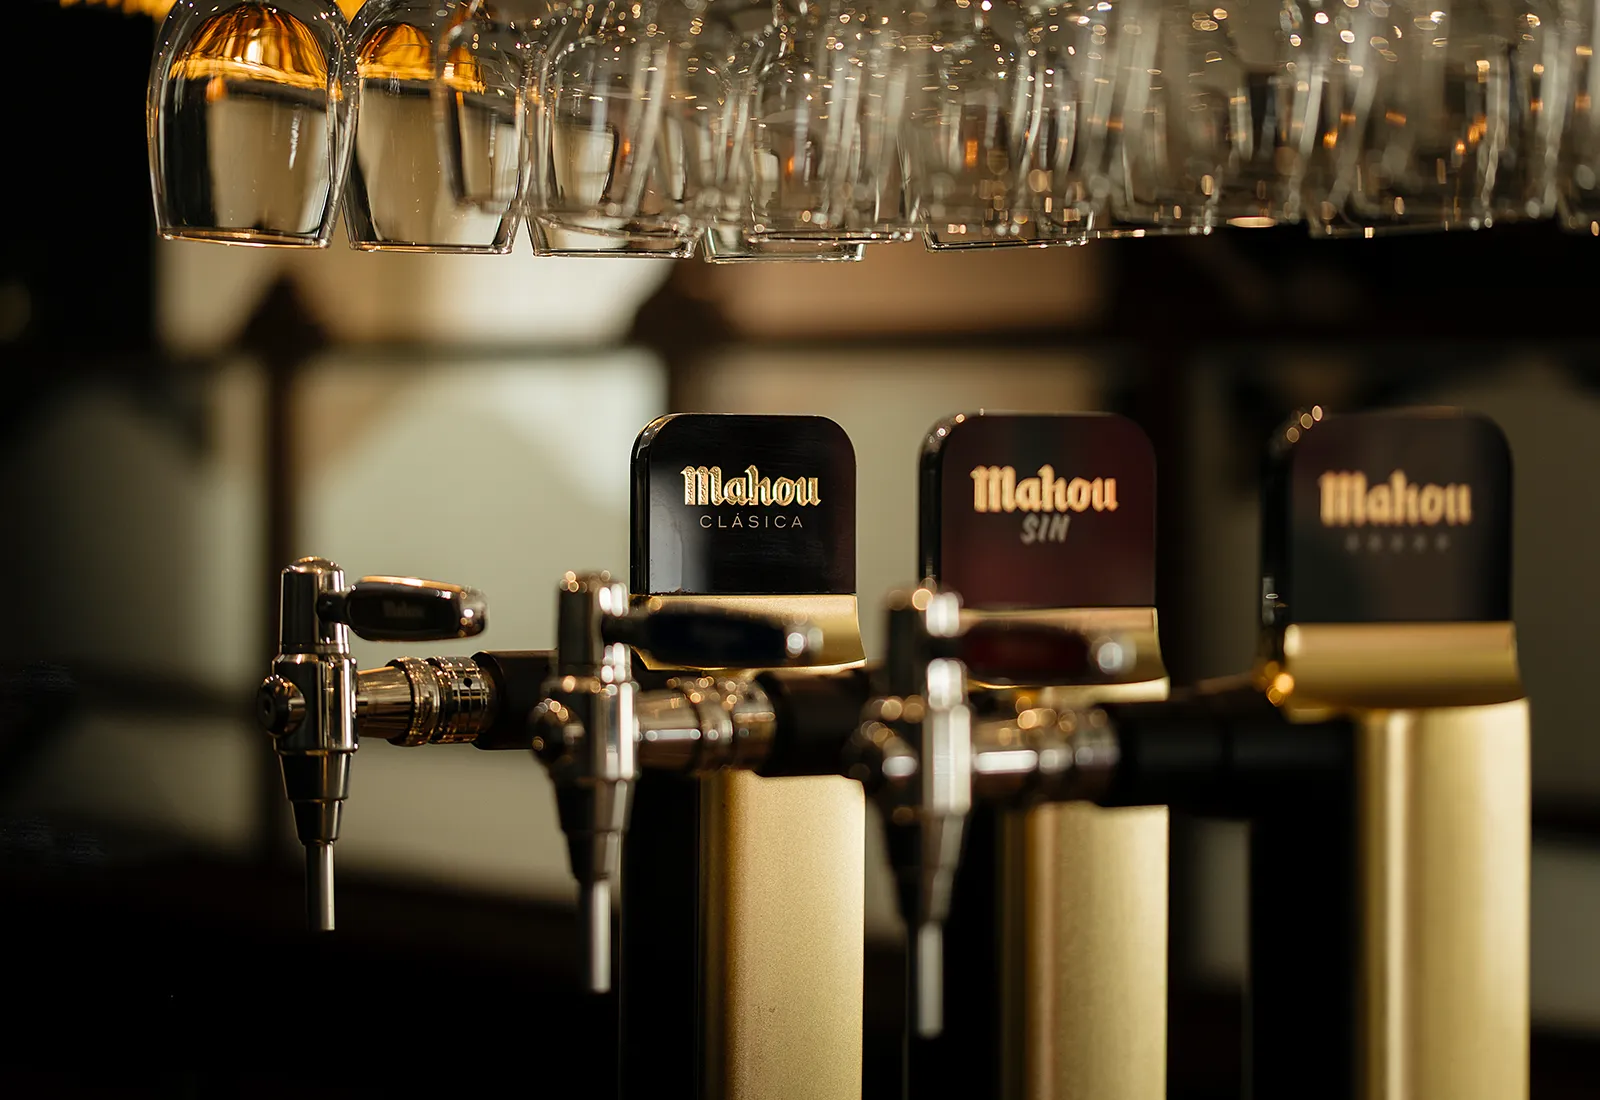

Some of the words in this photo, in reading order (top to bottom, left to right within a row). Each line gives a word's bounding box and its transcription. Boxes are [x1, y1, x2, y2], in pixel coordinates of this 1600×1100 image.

[680, 465, 821, 506] Mahou
[970, 464, 1119, 512] Mahou
[1319, 469, 1471, 526] Mahou
[699, 512, 803, 528] CLÁSICA
[1020, 513, 1071, 544] SIN
